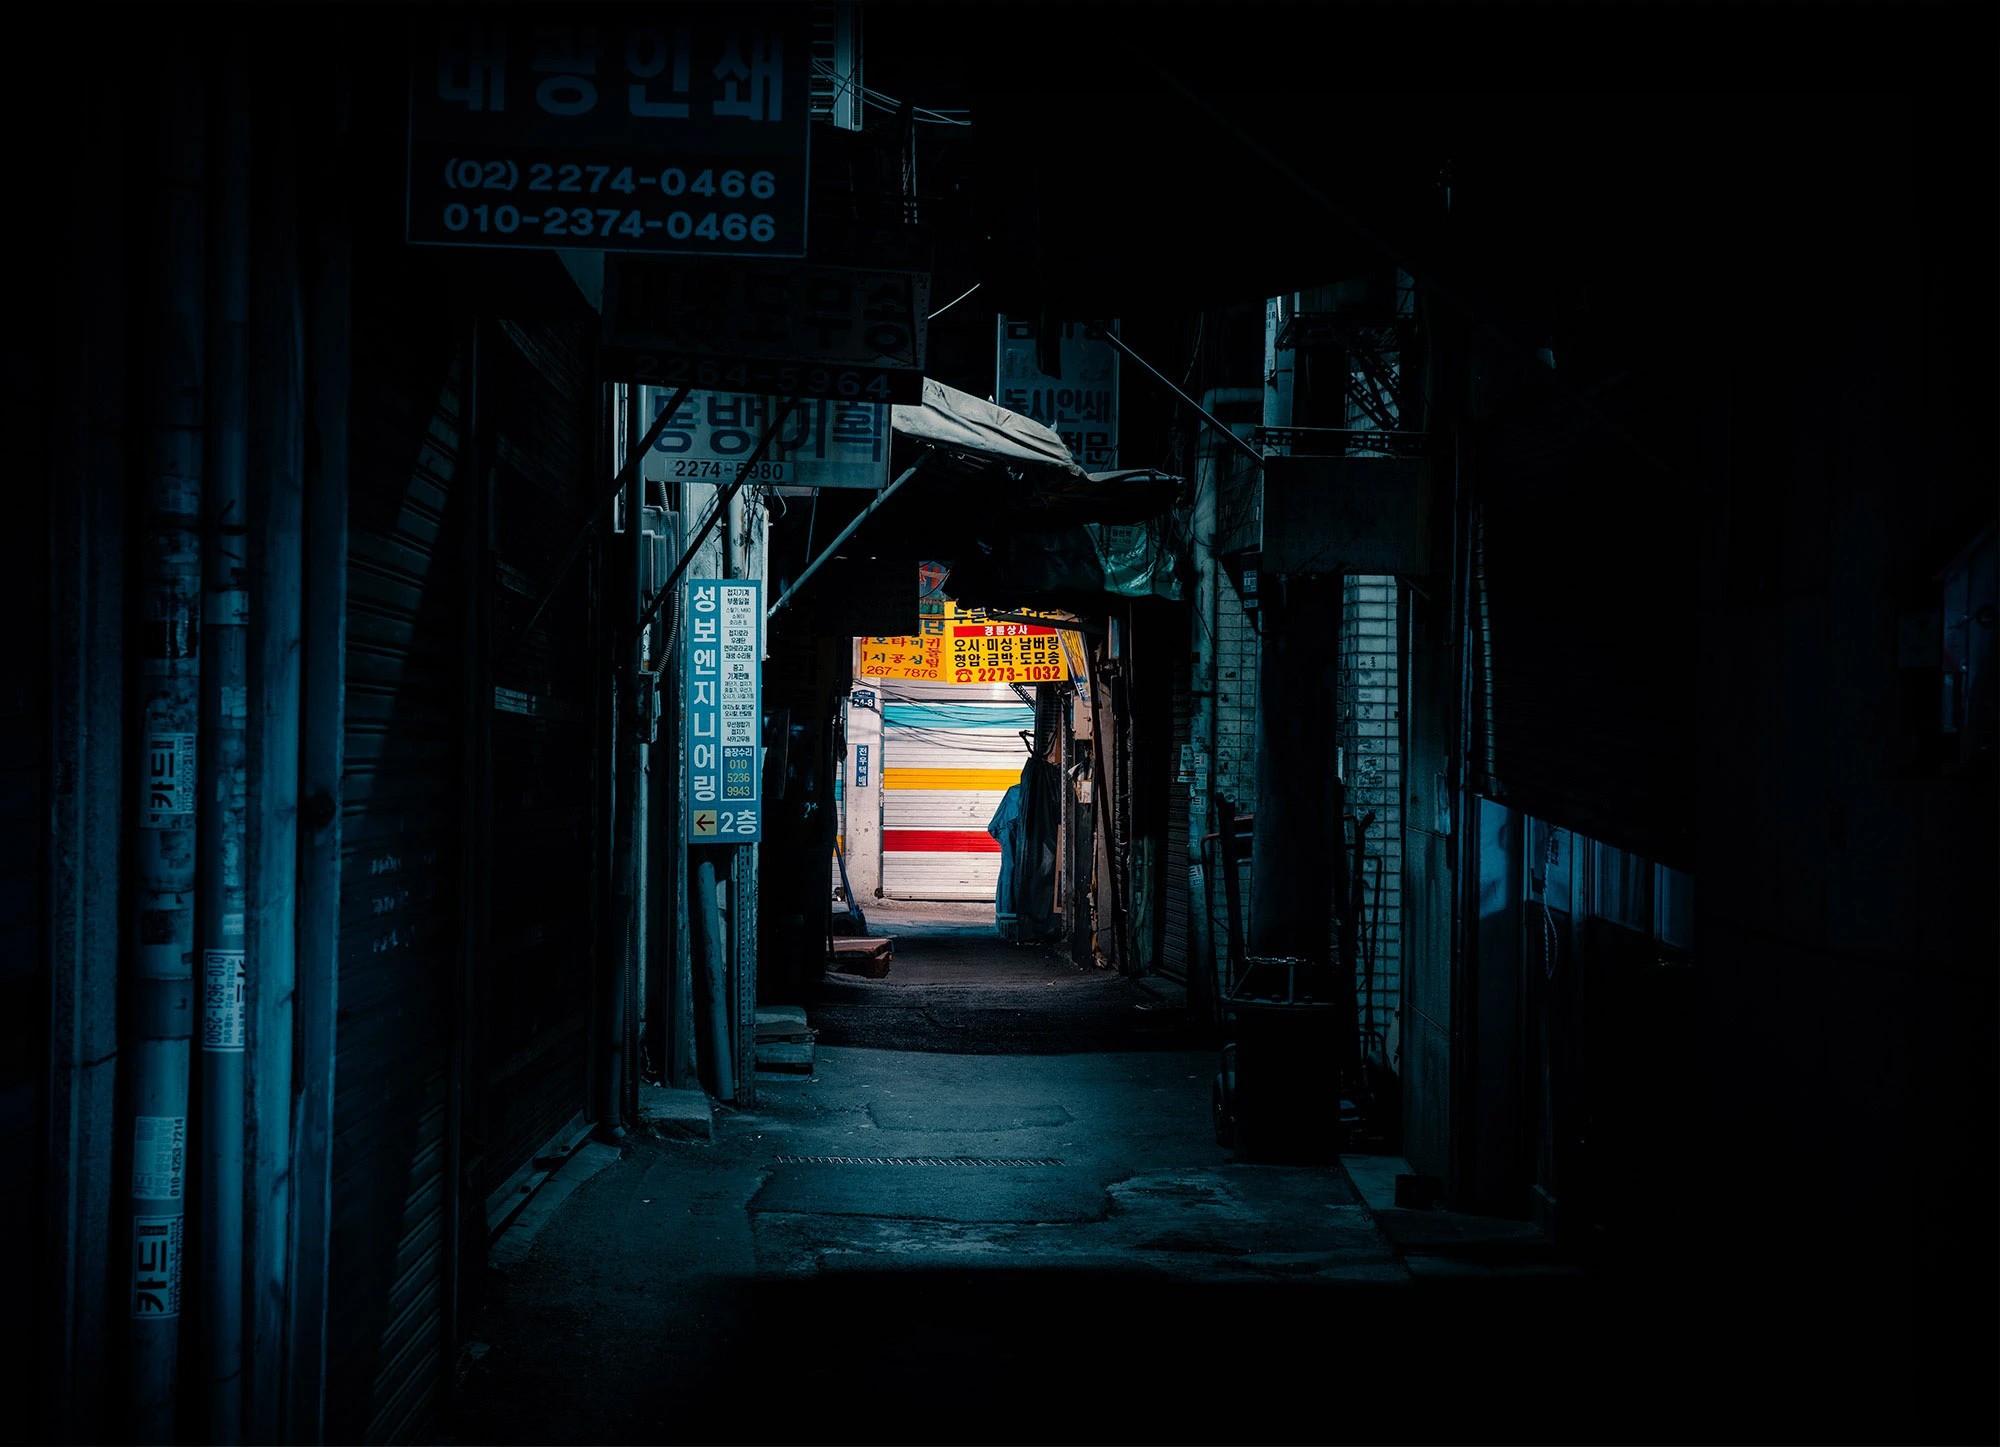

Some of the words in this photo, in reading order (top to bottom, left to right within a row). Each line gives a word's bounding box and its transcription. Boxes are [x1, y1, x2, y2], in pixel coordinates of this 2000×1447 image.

[437, 19, 784, 122] 대광인쇄
[444, 157, 519, 191] (02)
[528, 163, 776, 199] 2274-0466
[443, 203, 776, 242] 010-2374-0466
[633, 354, 892, 399] 2264-5964
[675, 459, 784, 481] 2274-5980
[977, 665, 1061, 682] 2273-1032
[693, 586, 717, 802] 성보엔지니어링
[729, 759, 748, 769] 010
[727, 772, 750, 783] 5236
[726, 786, 751, 797] 9943
[720, 809, 758, 835] 2층
